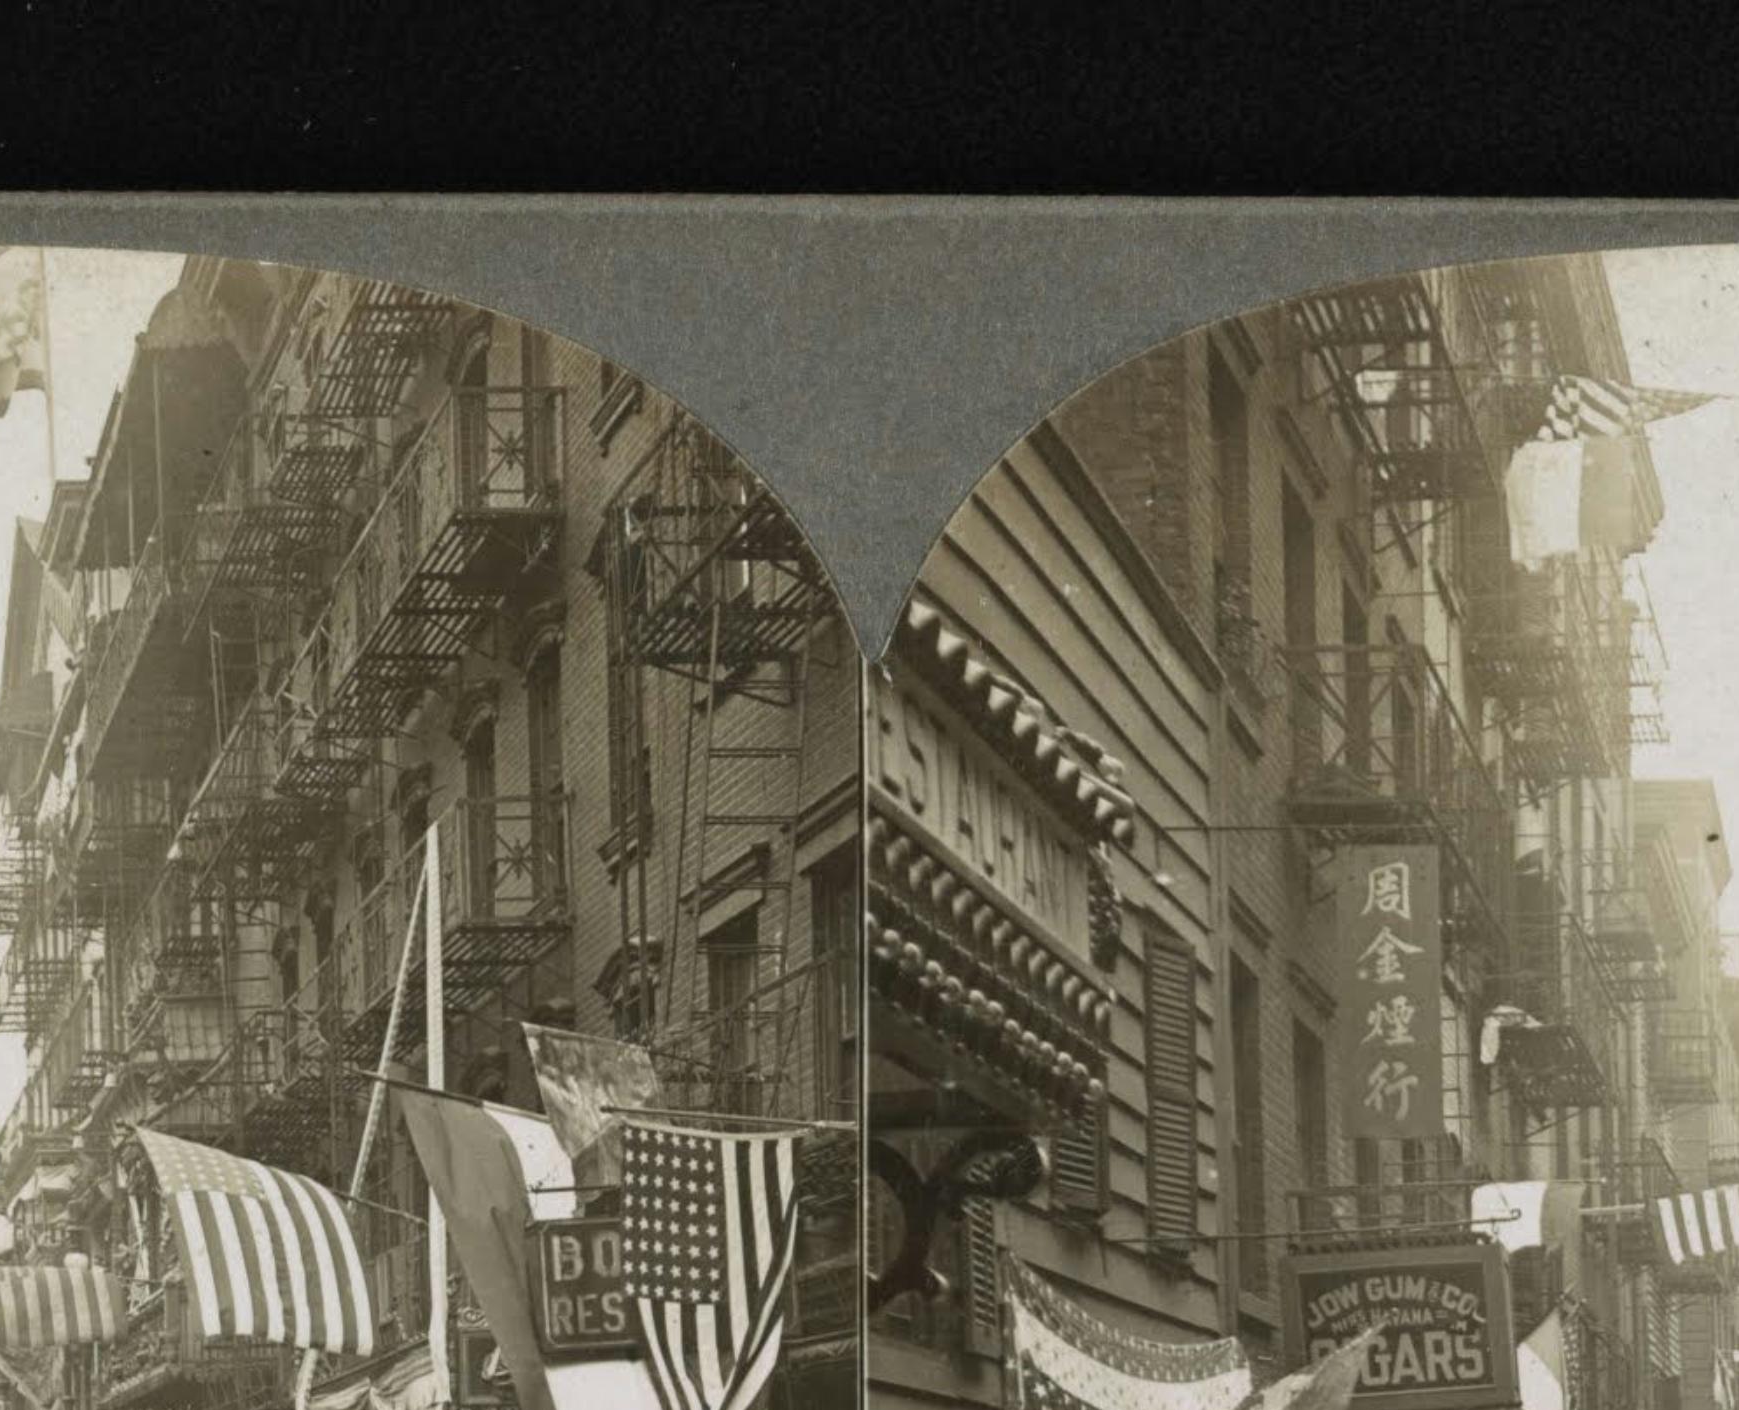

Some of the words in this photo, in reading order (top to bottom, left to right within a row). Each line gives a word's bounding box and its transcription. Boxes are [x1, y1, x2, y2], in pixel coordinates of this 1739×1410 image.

[1308, 1282, 1359, 1328] JOW
[1365, 1275, 1427, 1302] GUM
[1310, 1331, 1484, 1386] CGARS
